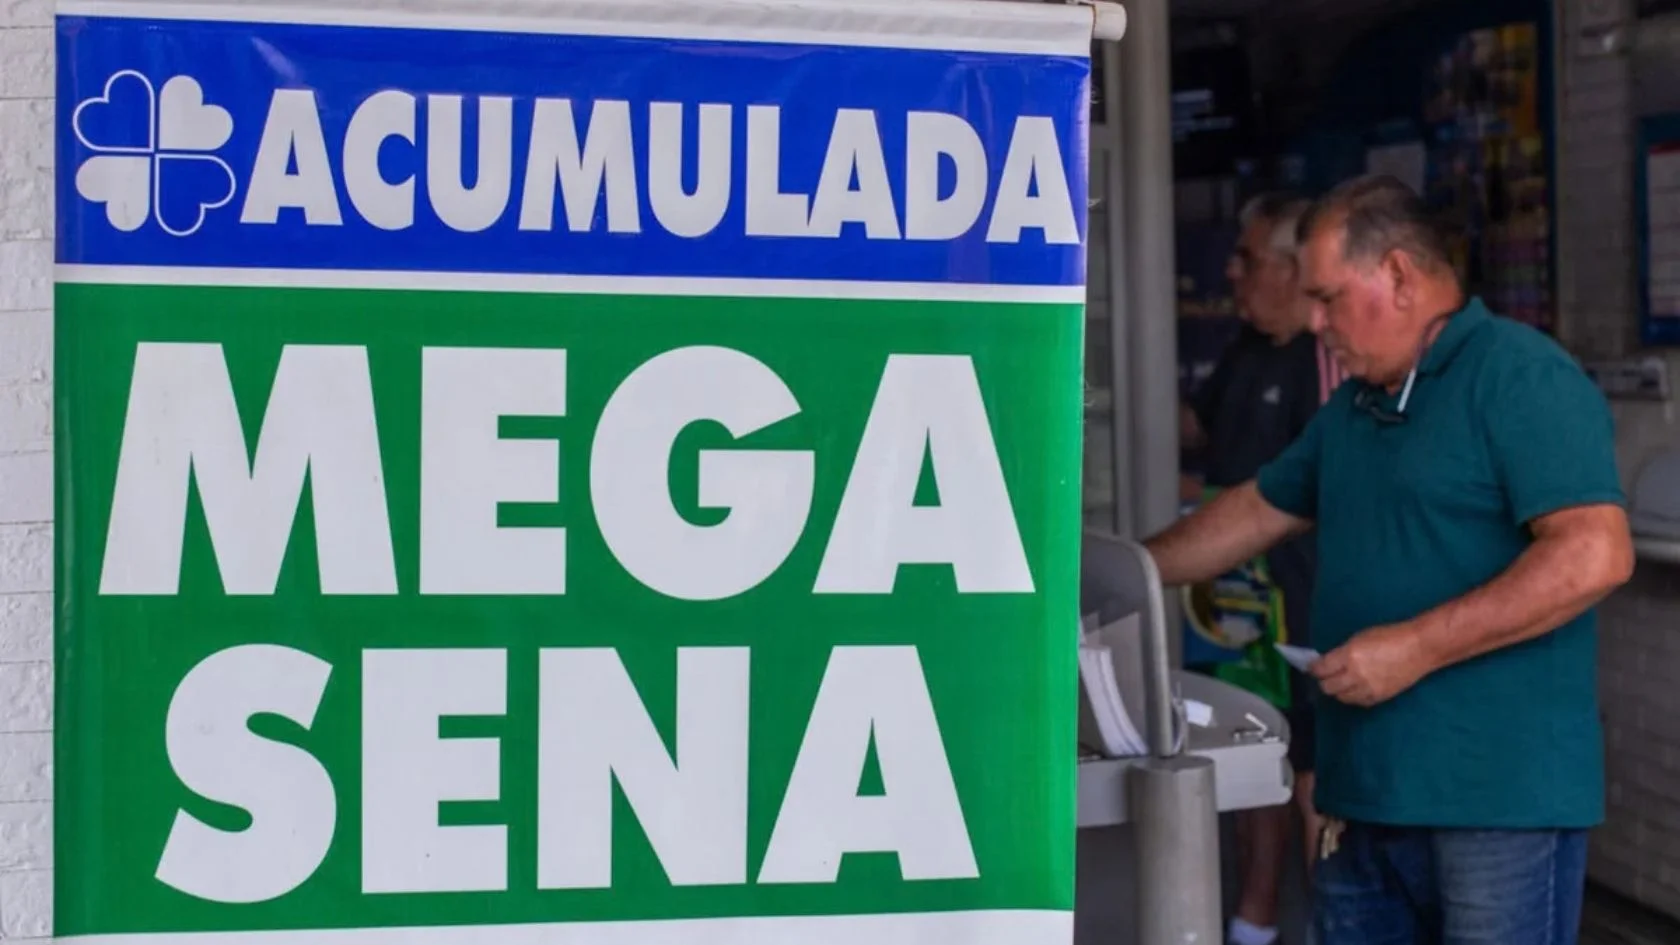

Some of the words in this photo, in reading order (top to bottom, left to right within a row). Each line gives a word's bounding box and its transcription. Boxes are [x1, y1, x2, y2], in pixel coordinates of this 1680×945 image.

[240, 89, 1081, 246] ACUMULADA
[99, 342, 1036, 600] MEGA
[155, 643, 980, 903] SENA
